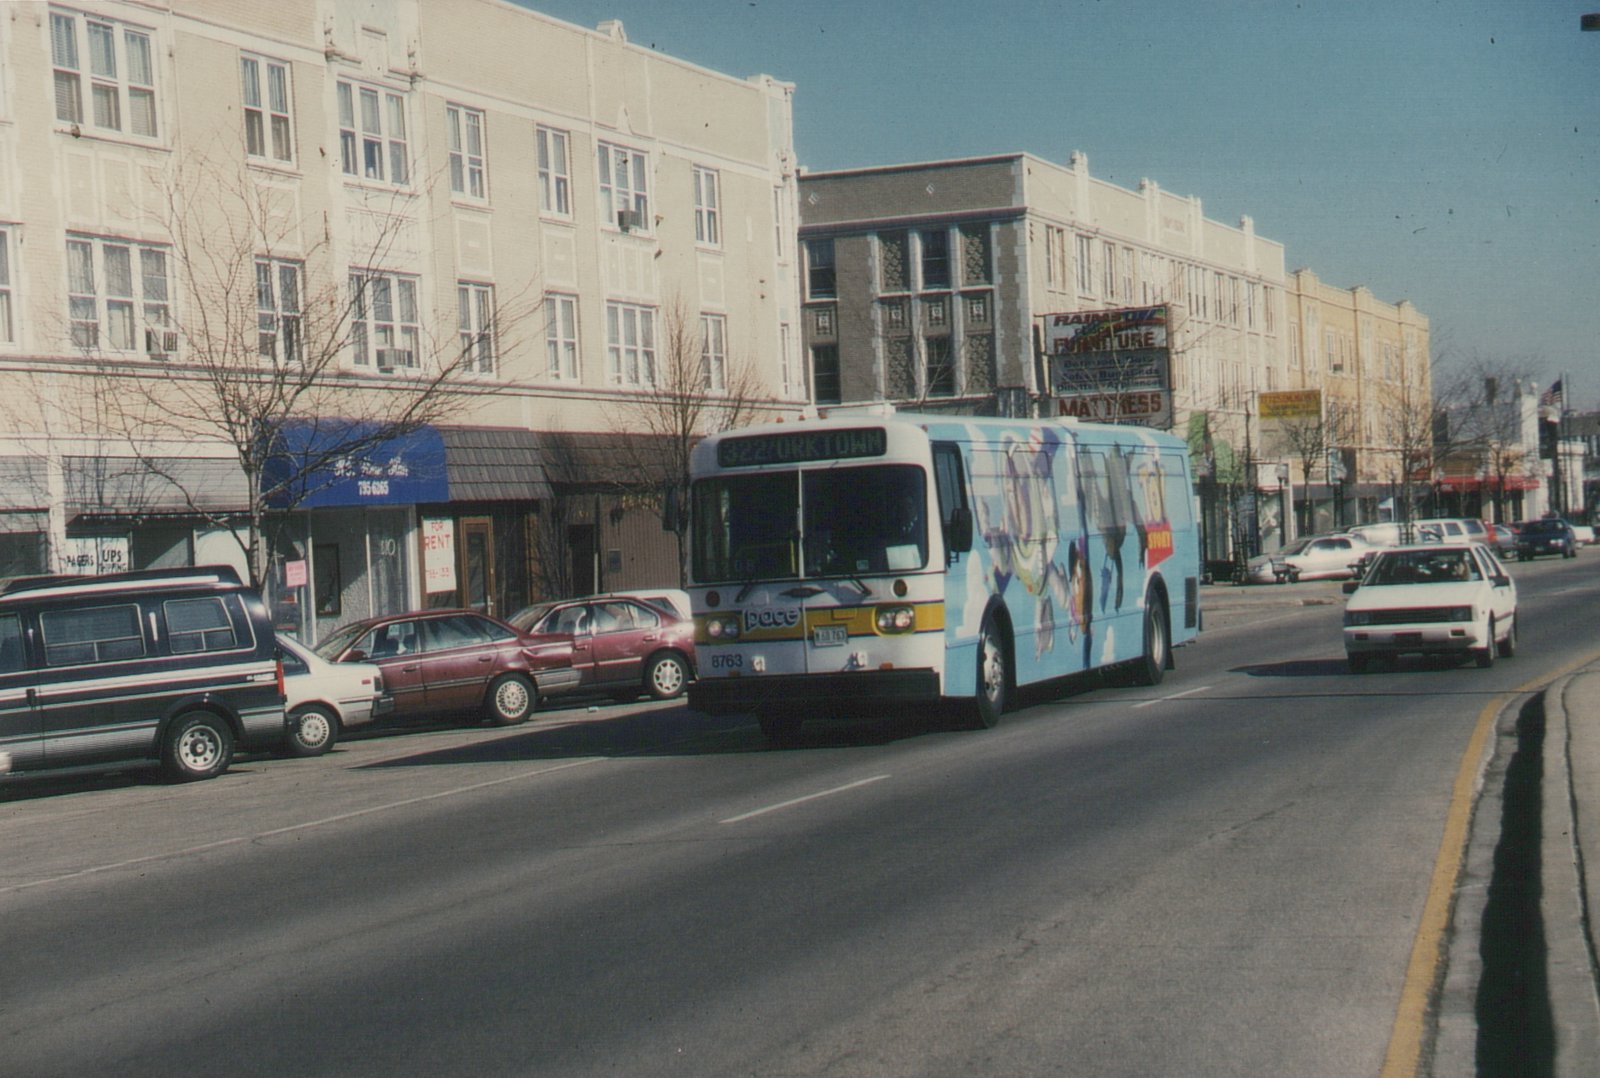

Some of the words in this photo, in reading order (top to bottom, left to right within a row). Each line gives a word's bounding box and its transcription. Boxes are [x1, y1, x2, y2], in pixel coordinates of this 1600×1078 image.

[1058, 393, 1162, 417] MATTRESS
[424, 534, 451, 550] RENT
[102, 549, 122, 563] UPS
[744, 609, 799, 631] pace
[711, 654, 743, 668] 8763
